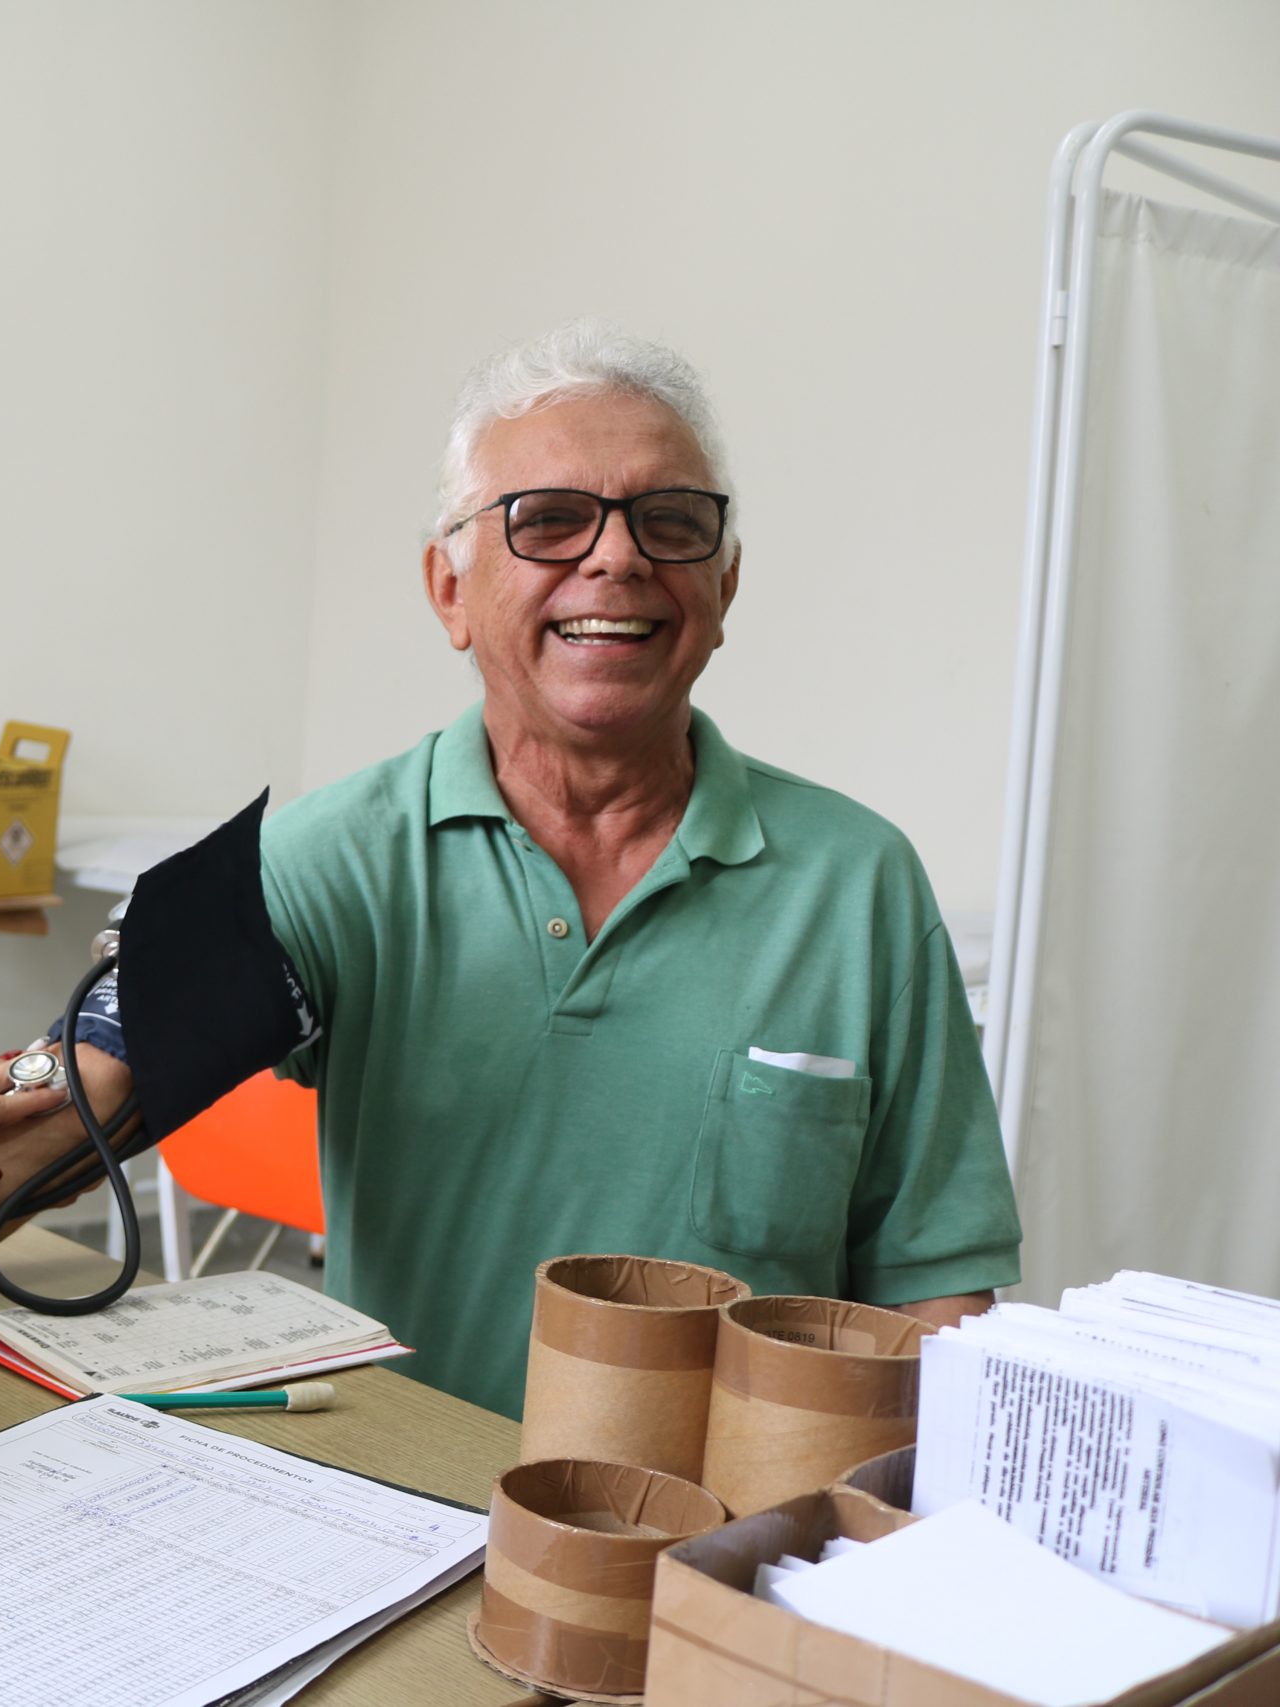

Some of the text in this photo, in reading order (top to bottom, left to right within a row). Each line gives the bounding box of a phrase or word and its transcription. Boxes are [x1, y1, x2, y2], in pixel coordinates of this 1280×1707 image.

[758, 1330, 785, 1341] OTE
[178, 1434, 210, 1449] FICHA
[211, 1444, 225, 1454] DE
[226, 1449, 315, 1484] PROCEDIMENTOS
